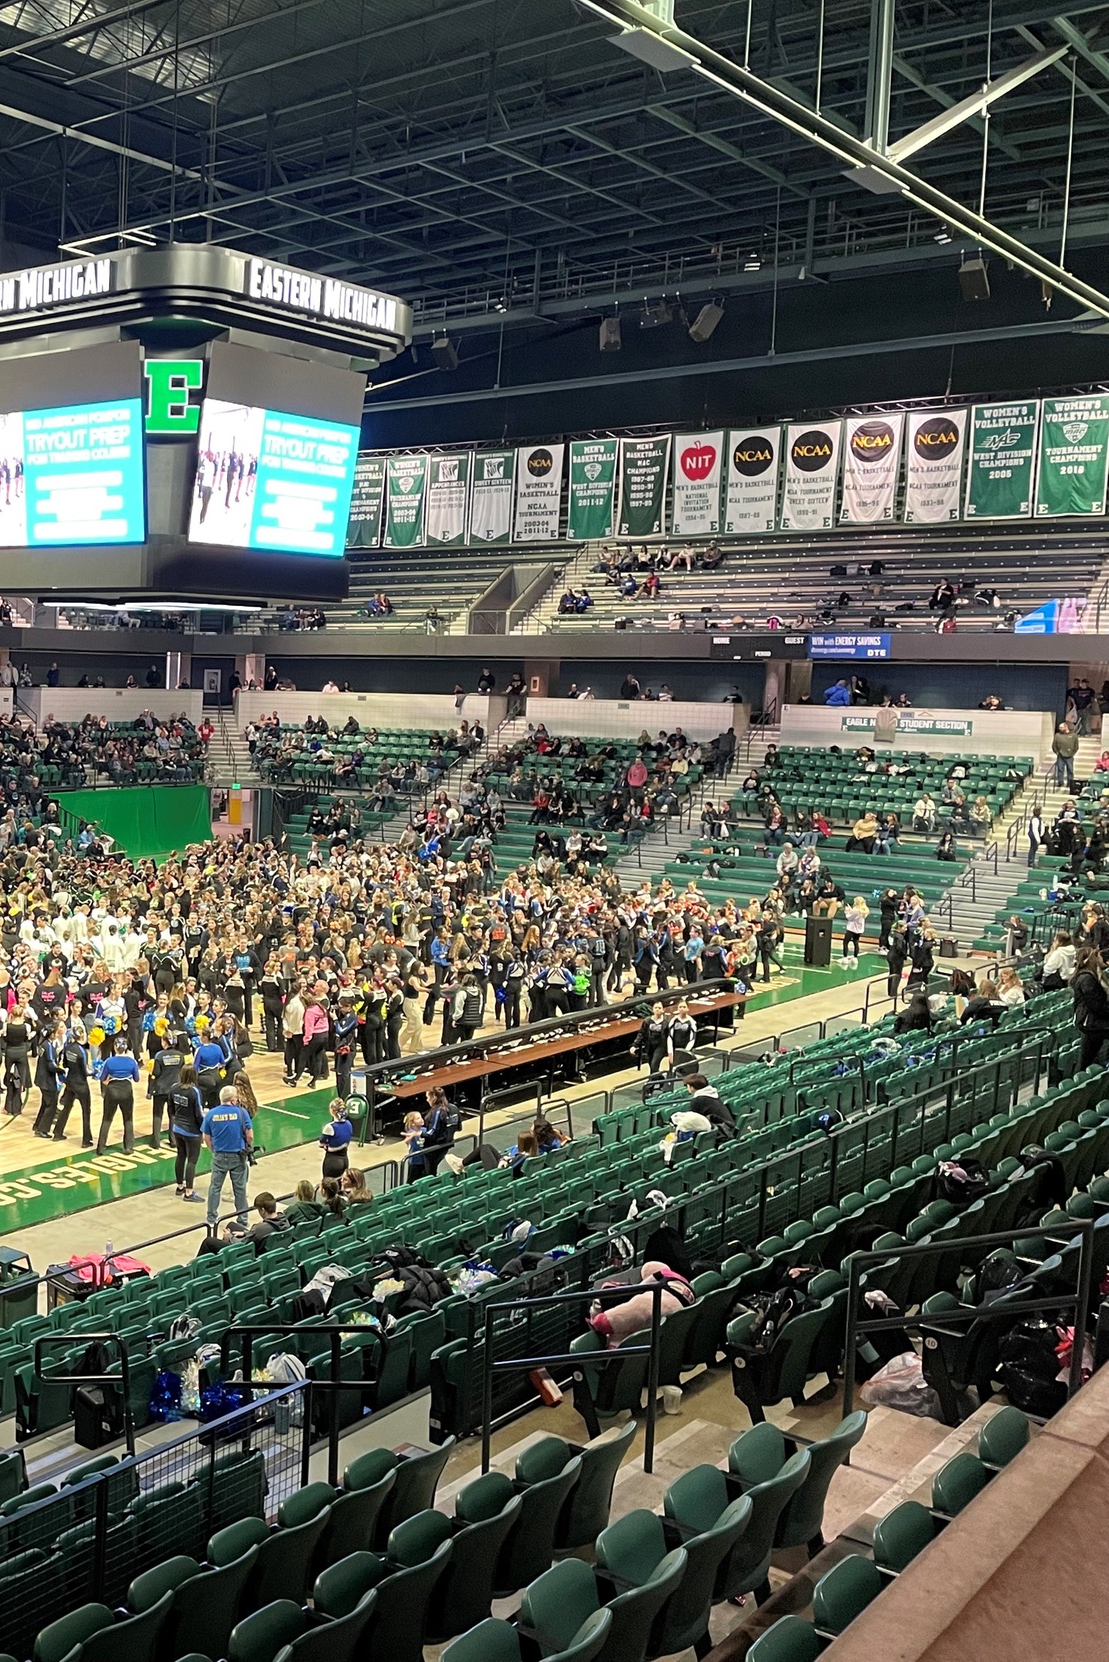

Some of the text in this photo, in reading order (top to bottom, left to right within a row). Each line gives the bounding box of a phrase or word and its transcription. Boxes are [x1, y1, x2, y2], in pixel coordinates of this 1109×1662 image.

[19, 258, 111, 310] MICHIGAN
[249, 257, 397, 332] EASTERN MICHIGAN
[144, 359, 203, 434] E
[1055, 400, 1101, 412] WOMEN'S
[983, 407, 1028, 419] WOMEN'S
[1045, 410, 1109, 423] VOLLEYBALL
[975, 416, 1035, 428] VOLLEYBALL
[26, 424, 131, 452] TRYOUT PREP
[853, 434, 892, 447] NCAA
[916, 432, 957, 446] NCAA
[264, 434, 349, 465] TRYOUT PREP
[584, 446, 605, 454] MEN'S
[626, 450, 663, 459] BASKETBALL
[793, 444, 831, 457] NCAA
[974, 449, 1032, 460] WEST DIVISION
[1045, 445, 1103, 455] TOURNAMENT
[573, 453, 615, 463] BASKETBALL
[735, 449, 771, 462] NCAA
[1050, 453, 1097, 463] CHAMPIONS
[395, 460, 420, 469] WOMEN'S
[528, 460, 551, 468] NCAA
[686, 454, 712, 469] NIT
[979, 458, 1024, 468] CHAMPIONS
[390, 467, 424, 477] BASKETBALL
[627, 466, 660, 474] CHAMPIONS
[926, 464, 959, 473] BASKETBALL
[989, 470, 1012, 479] 2005
[588, 481, 612, 489] DIVISION
[690, 482, 718, 490] BASKETBALL
[745, 479, 775, 488] BASKETBALL
[923, 480, 958, 489] TOURNAMENT
[519, 490, 559, 498] BASKETBALL
[576, 489, 608, 497] CHAMPIONS
[800, 486, 832, 495] TOURNAMENT
[578, 498, 604, 506] 2011-12
[743, 495, 774, 503] TOURNAMENT
[681, 504, 712, 512] TOURNAMENT
[967, 505, 976, 514] E
[1020, 502, 1028, 511] E
[1038, 504, 1048, 514] E
[1091, 502, 1102, 512] E
[519, 510, 558, 518] TOURNAMENT
[841, 509, 849, 519] E
[884, 508, 892, 518] E
[905, 512, 913, 522] E
[949, 509, 957, 519] E
[652, 521, 659, 532] E
[710, 521, 717, 531] E
[766, 520, 773, 530] E
[782, 518, 790, 528] E
[823, 517, 830, 526] E
[621, 524, 629, 534] E
[674, 524, 680, 533] E
[726, 522, 733, 532] E
[442, 530, 450, 540] E
[486, 530, 494, 539] E
[516, 531, 523, 539] E
[784, 636, 804, 644] GUEST
[812, 636, 824, 646] WIN
[835, 636, 856, 646] ENERGY
[856, 636, 882, 646] SAVINGS
[846, 717, 868, 726] EAGLE
[900, 720, 934, 729] STUDENT
[936, 720, 968, 730] SECTION
[928, 1340, 936, 1348] 10
